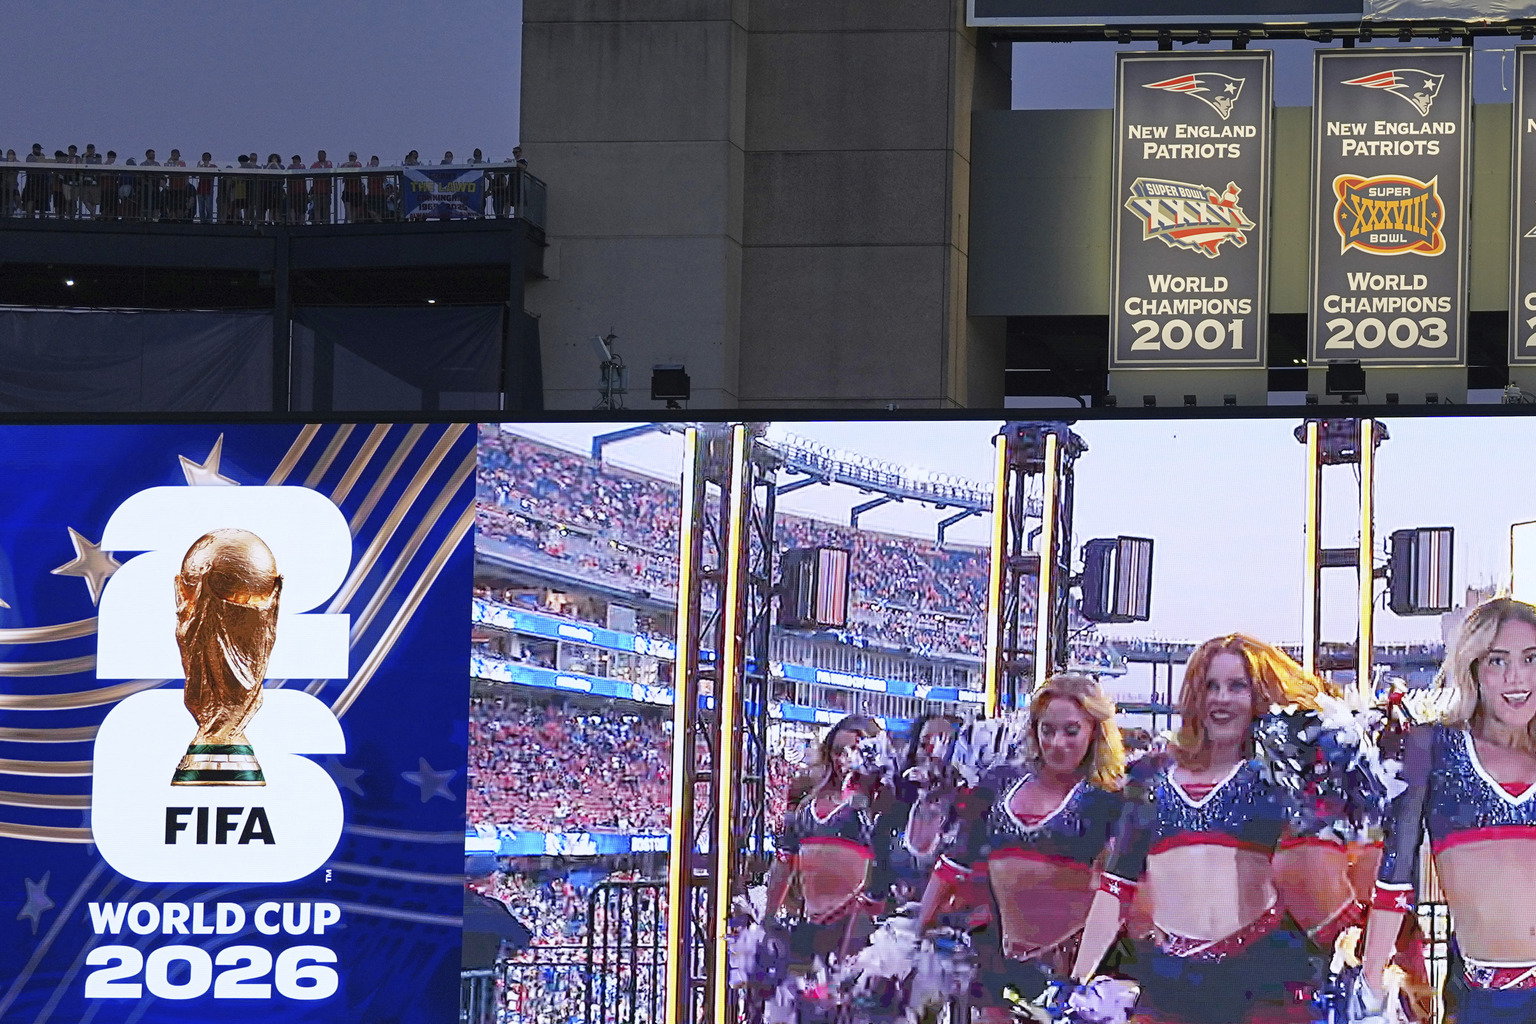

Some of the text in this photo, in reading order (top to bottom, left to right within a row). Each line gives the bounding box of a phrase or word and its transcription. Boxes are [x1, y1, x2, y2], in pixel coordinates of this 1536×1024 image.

[1128, 123, 1257, 139] NEW ENGLAND
[1327, 121, 1456, 136] NEW ENGLAND
[1143, 141, 1241, 159] PATRIOTS
[1341, 138, 1440, 157] PATRIOTS
[1146, 182, 1206, 200] SUPER BOWL
[1369, 187, 1411, 198] SUPER
[1369, 234, 1408, 243] BOWL
[1148, 275, 1229, 293] WORLD
[1347, 272, 1428, 291] WORLD
[1124, 297, 1252, 316] CHAMPIONS
[1323, 295, 1452, 315] CHAMPIONS
[1131, 319, 1244, 351] 2001
[1325, 317, 1448, 350] 2003
[164, 807, 276, 845] FIFA
[88, 901, 342, 935] WORLD CUP
[84, 945, 339, 1000] 2026
